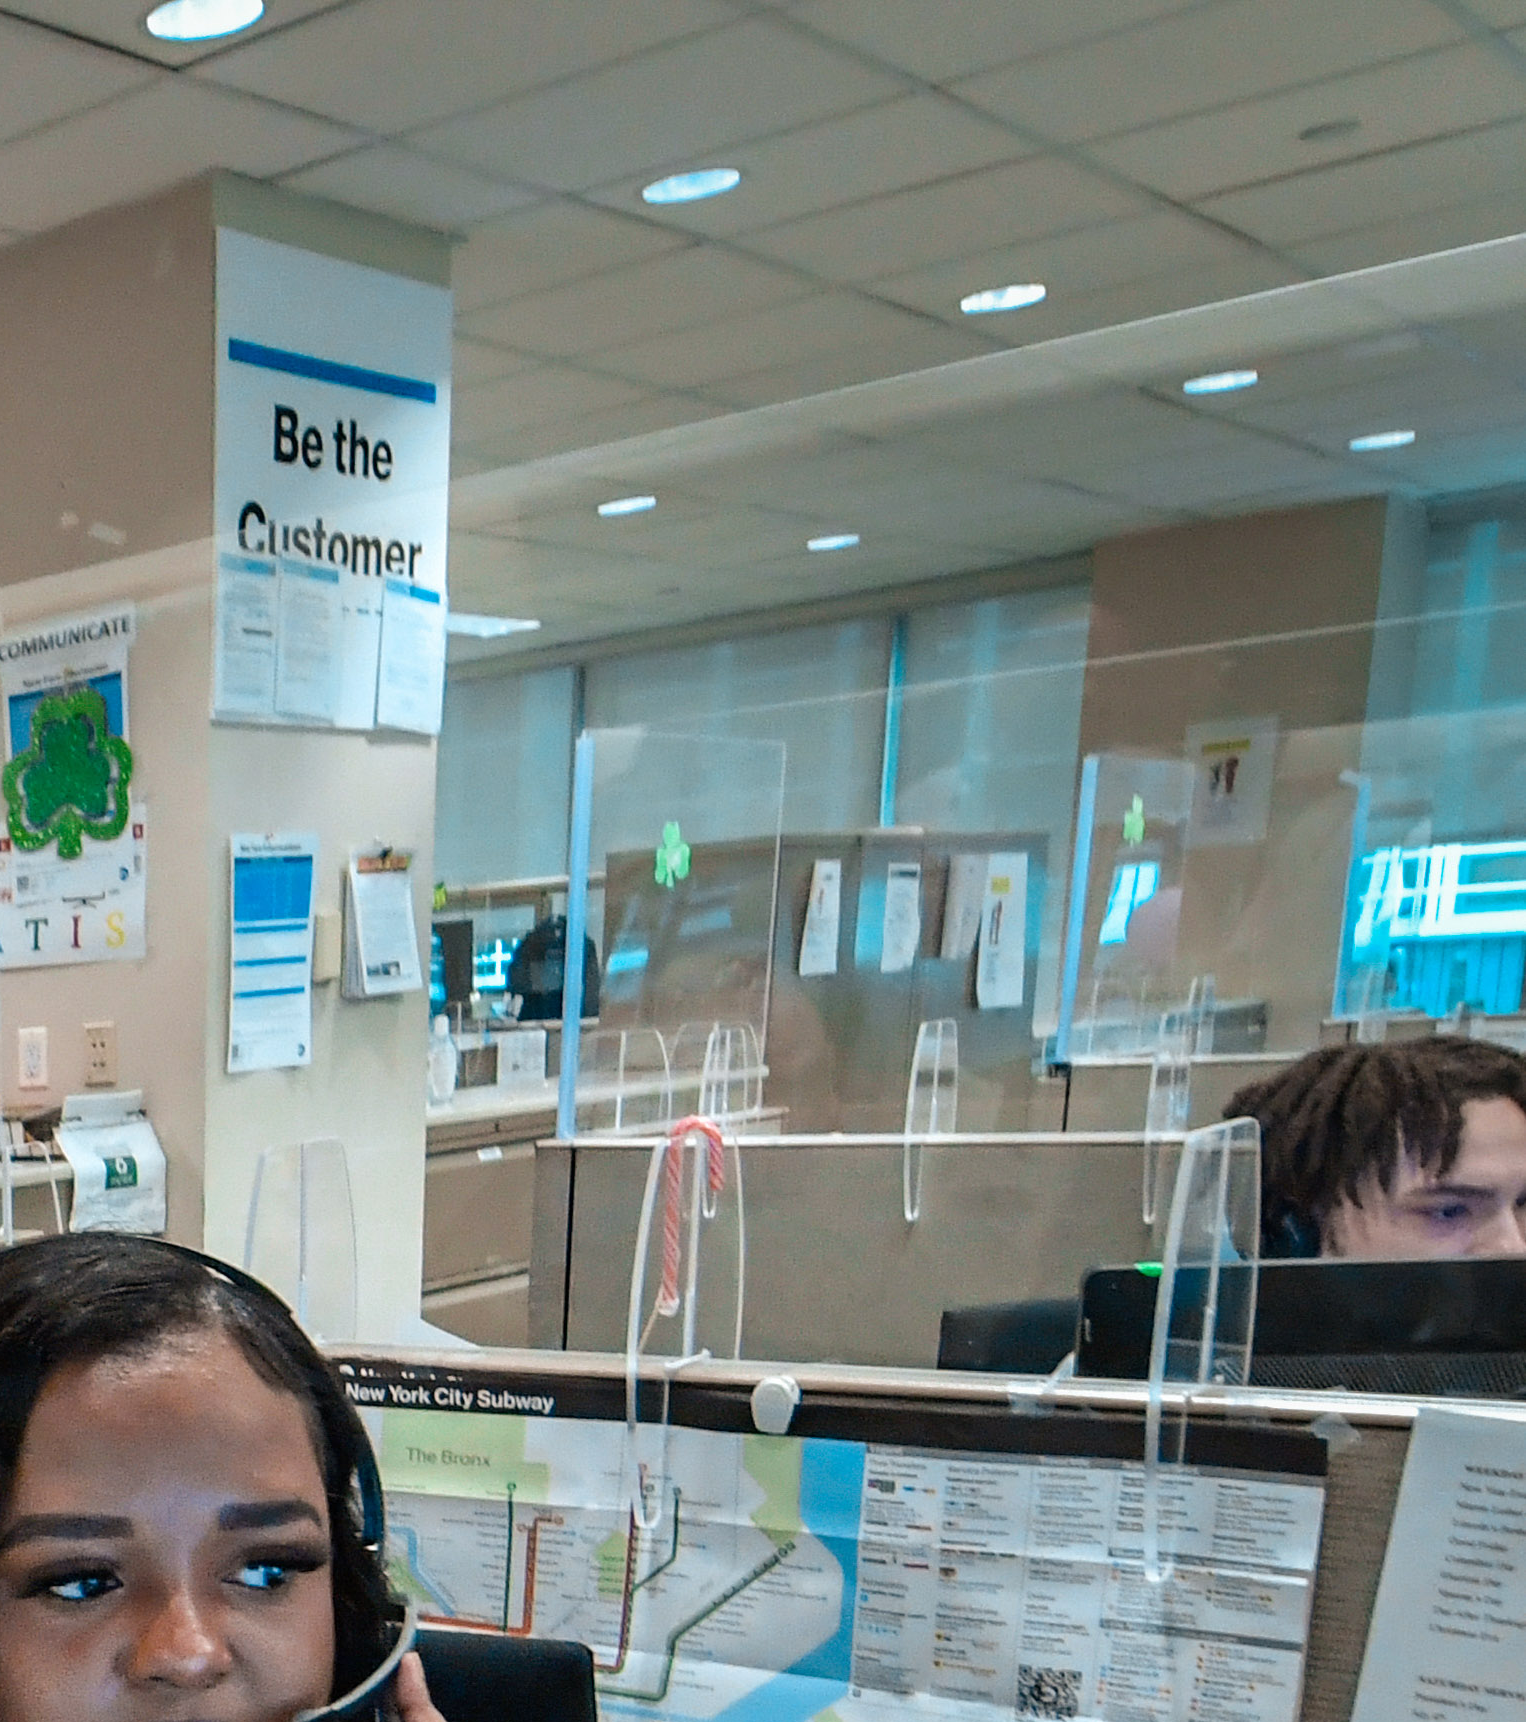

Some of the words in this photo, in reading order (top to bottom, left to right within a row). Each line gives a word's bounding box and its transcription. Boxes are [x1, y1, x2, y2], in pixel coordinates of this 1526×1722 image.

[273, 404, 323, 469] Be
[332, 418, 393, 481] the
[237, 500, 423, 578] Customer
[345, 1382, 386, 1402] New
[388, 1384, 432, 1405] York
[434, 1387, 474, 1411] City
[476, 1389, 555, 1415] Subway
[405, 1446, 438, 1466] The
[441, 1448, 491, 1468] Bronx
